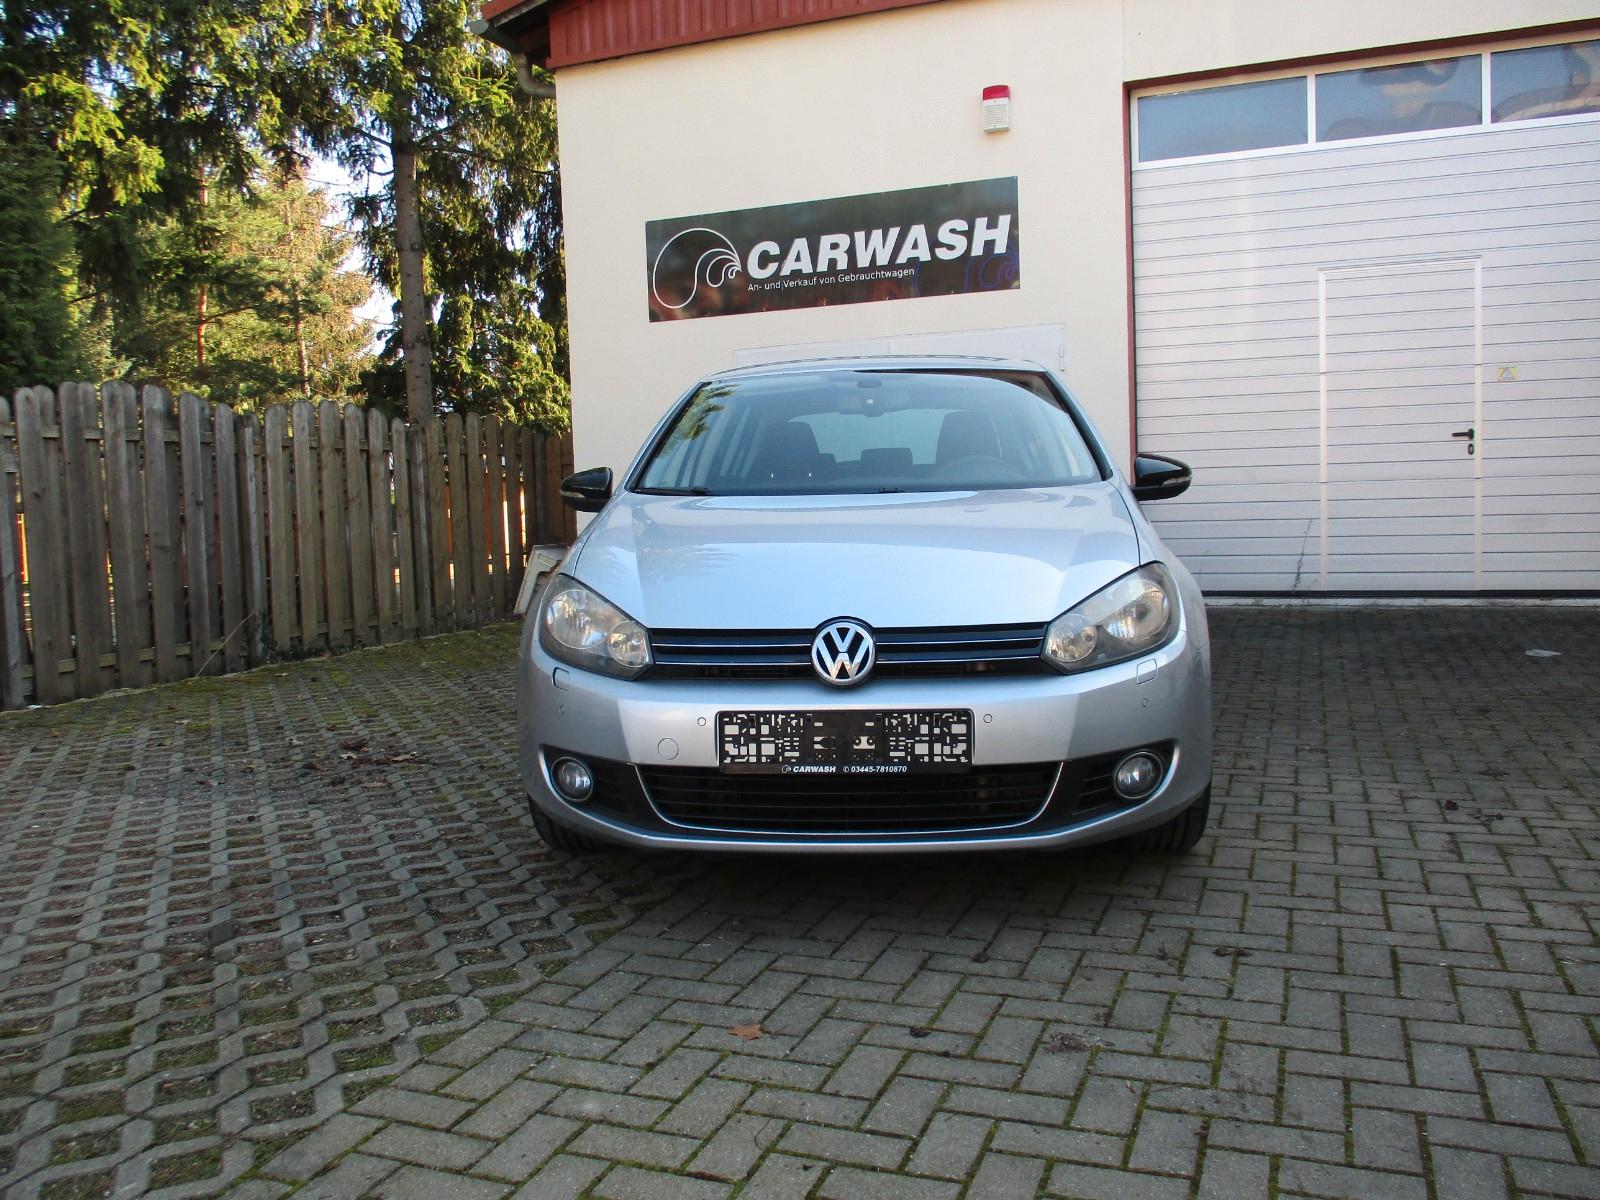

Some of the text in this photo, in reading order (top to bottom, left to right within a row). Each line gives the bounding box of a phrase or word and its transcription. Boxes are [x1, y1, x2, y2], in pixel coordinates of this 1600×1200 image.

[747, 214, 1011, 280] CARWASH
[748, 268, 915, 292] An- und Verkauf von Gebrauchtwagen
[813, 622, 875, 684] VW
